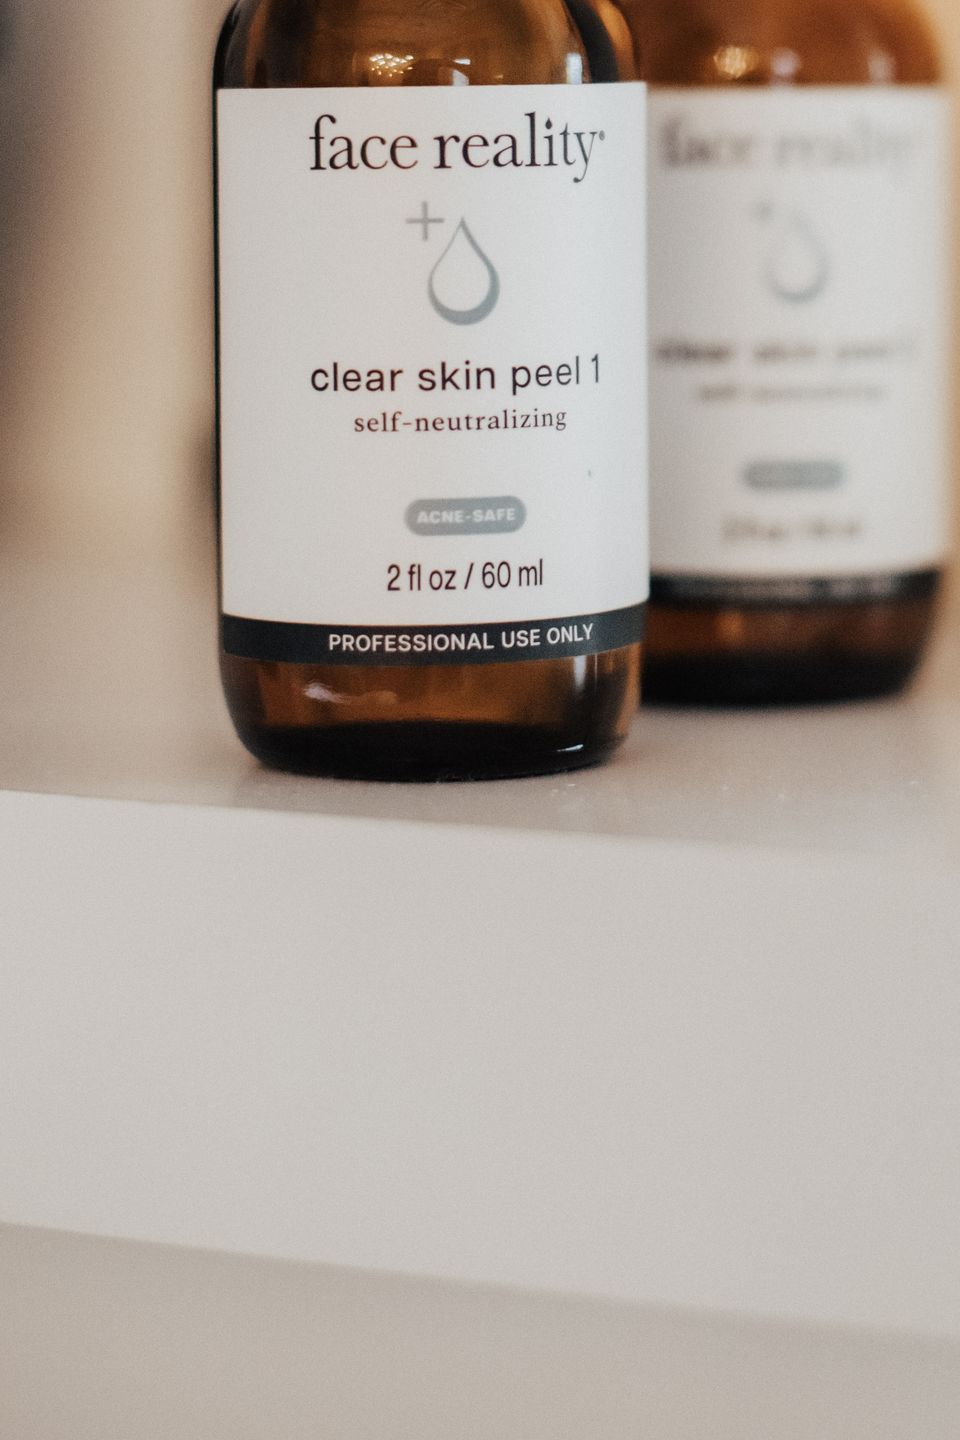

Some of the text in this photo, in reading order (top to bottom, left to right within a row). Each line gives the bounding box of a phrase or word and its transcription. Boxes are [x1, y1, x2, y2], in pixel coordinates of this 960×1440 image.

[308, 113, 419, 171] face
[310, 353, 600, 397] clear skin peel 1
[353, 407, 567, 433] self-neutralizing
[416, 508, 517, 525] ACNE-SAFE
[386, 558, 544, 592] 2 fl oz / 60 ml
[328, 622, 594, 652] PROFESSIONAL USE ONLY
